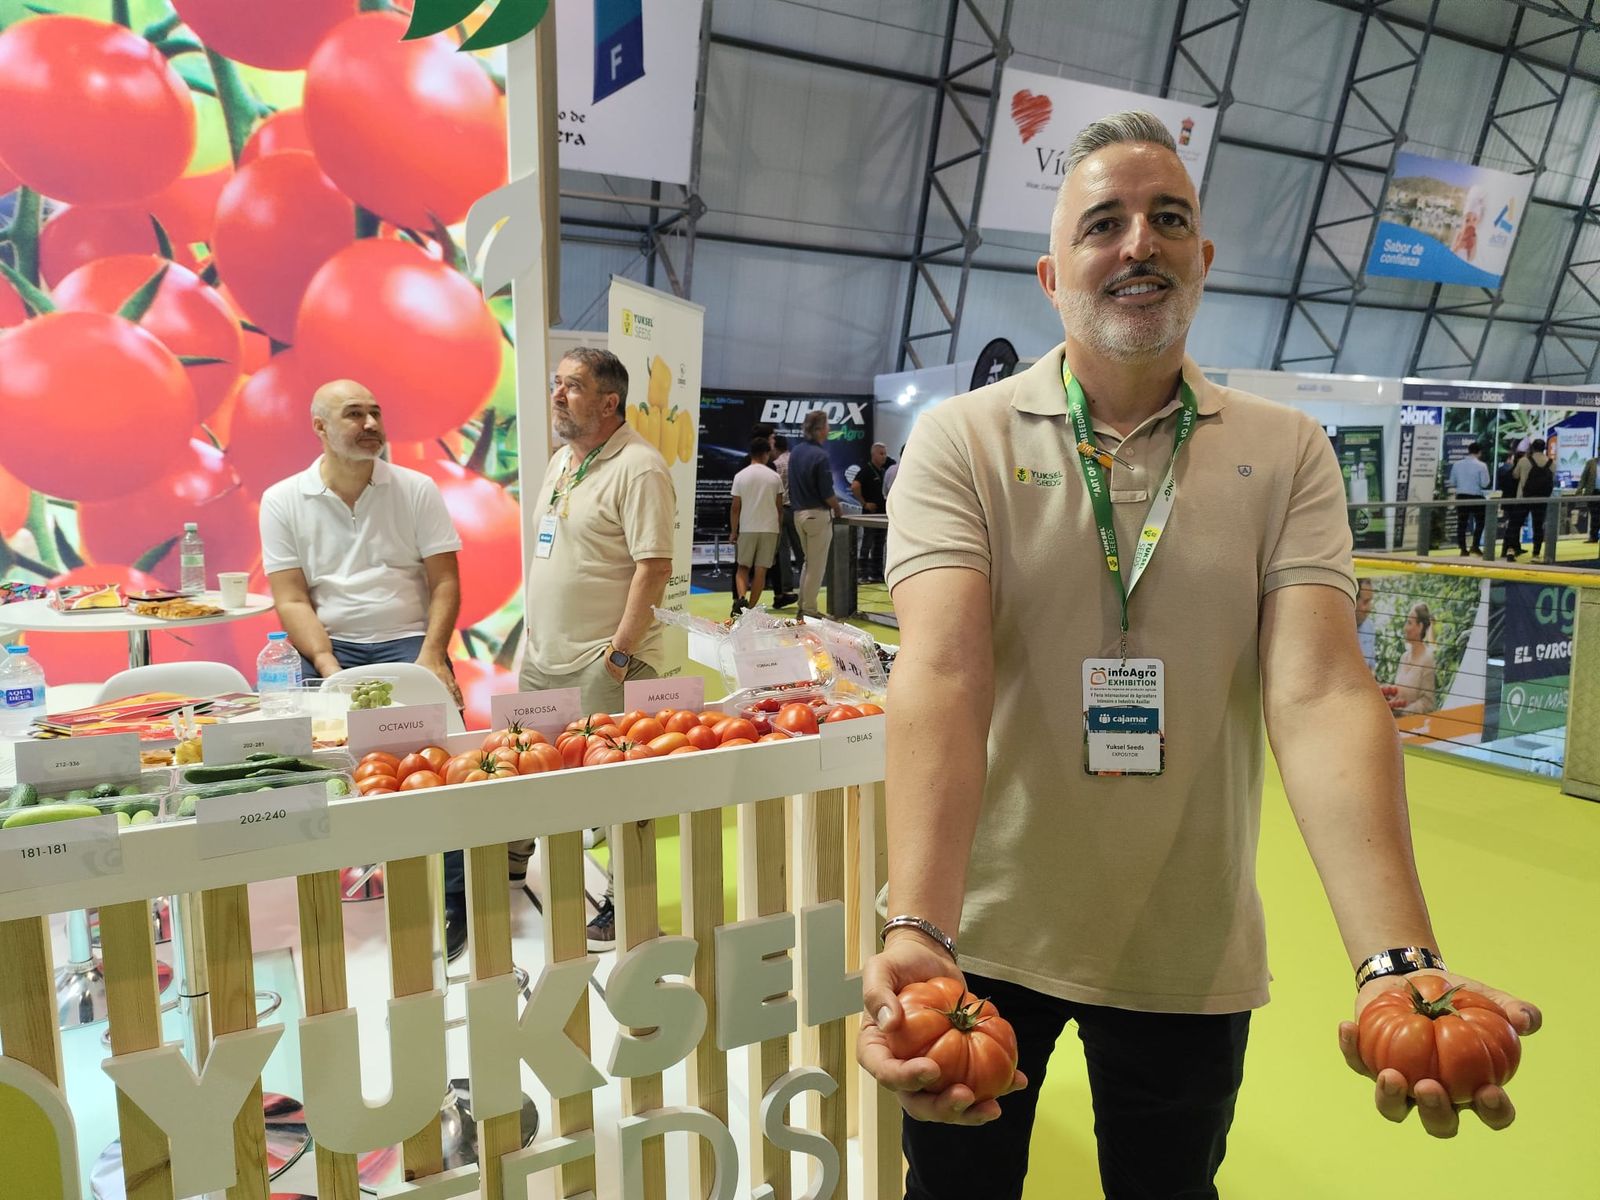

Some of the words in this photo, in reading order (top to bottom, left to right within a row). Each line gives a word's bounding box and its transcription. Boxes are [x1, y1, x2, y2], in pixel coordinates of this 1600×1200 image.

[610, 43, 622, 80] F
[1383, 238, 1411, 254] Sabor
[1411, 243, 1424, 256] de
[1379, 252, 1420, 267] confianza
[633, 313, 654, 328] YUKSEL
[760, 399, 868, 425] BIHOX
[841, 424, 865, 441] Agro
[1031, 469, 1064, 479] YUKSEL
[1036, 479, 1062, 487] SEEDS
[1099, 527, 1111, 556] YUKSEL
[1106, 529, 1117, 554] SEEDS
[1514, 645, 1533, 664] EL
[1108, 667, 1157, 680] infoAgro
[7, 689, 32, 697] AQUA
[647, 691, 680, 702] MARCUS
[513, 704, 558, 717] TOBROSSA
[378, 720, 425, 732] OCTAVIUS
[1112, 714, 1148, 724] cajamar
[243, 741, 265, 749] 202-281
[846, 732, 873, 744] TOBIAS
[55, 760, 80, 768] 212-336
[240, 808, 287, 825] 202-240
[21, 843, 67, 859] 181-181
[101, 900, 864, 1199] YUKSEL
